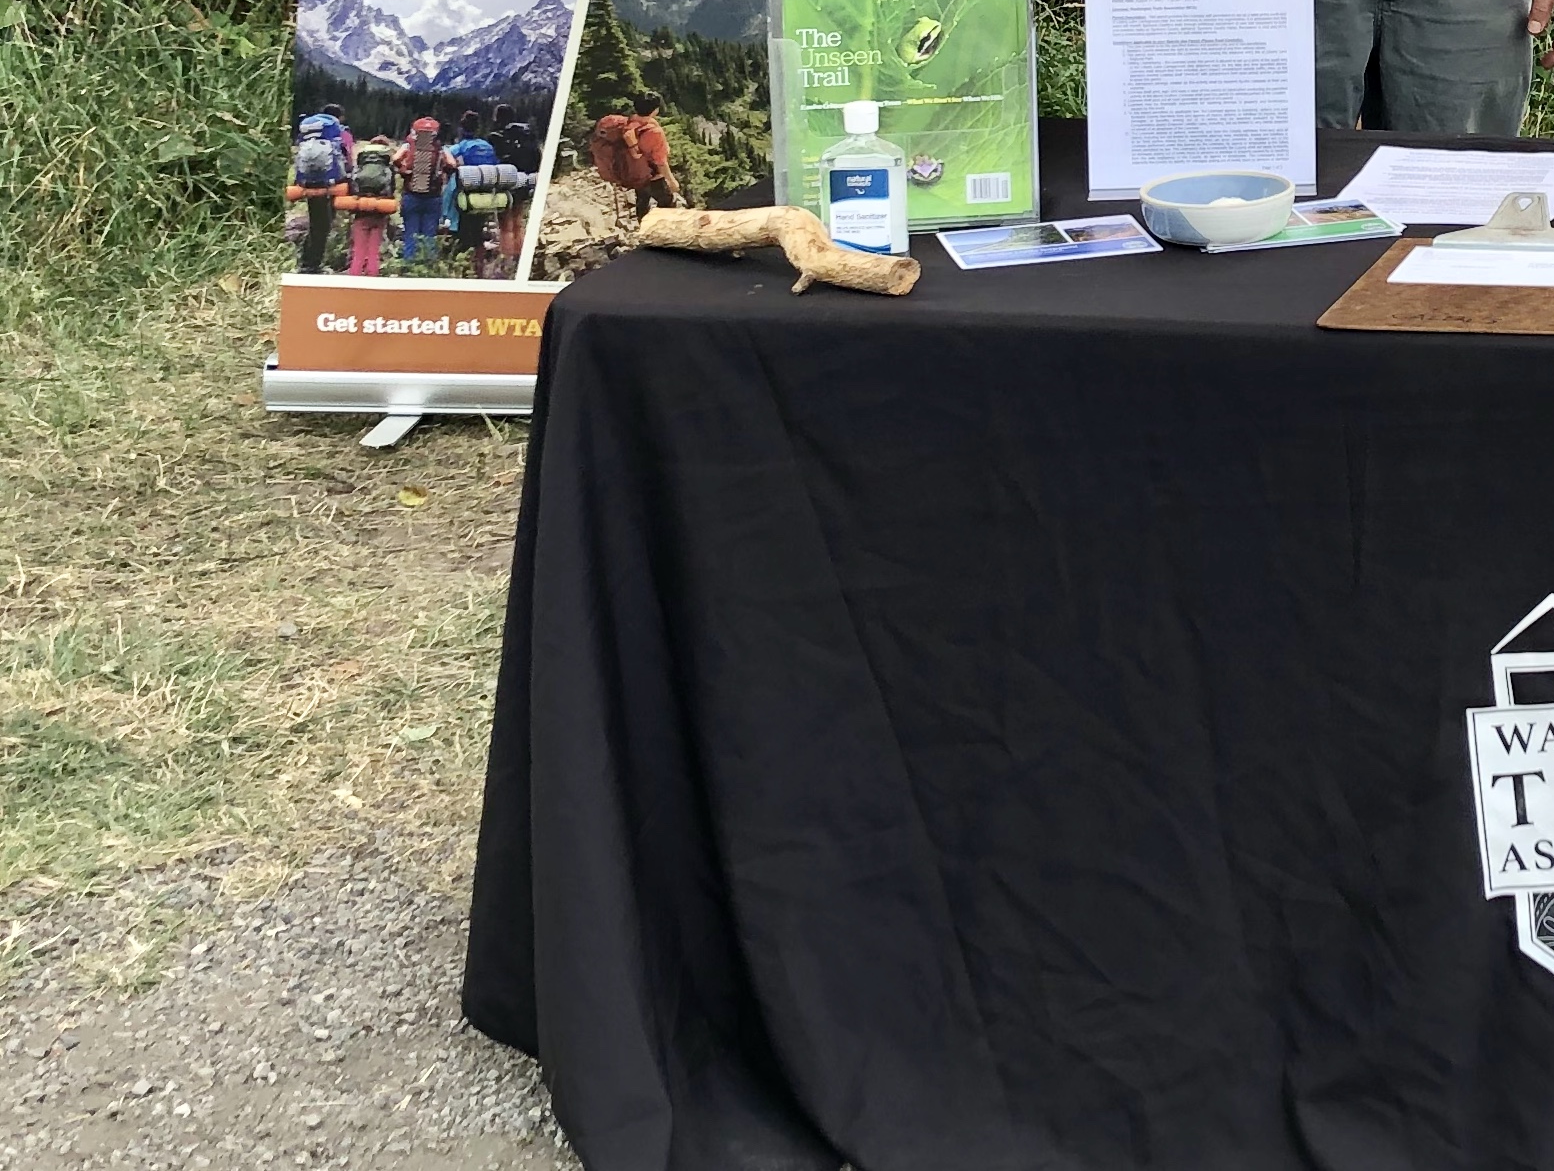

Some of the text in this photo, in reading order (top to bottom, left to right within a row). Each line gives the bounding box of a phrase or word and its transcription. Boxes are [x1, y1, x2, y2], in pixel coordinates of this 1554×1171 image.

[796, 28, 842, 48] The
[799, 48, 883, 69] Unseen
[797, 66, 851, 88] Trail
[316, 313, 358, 333] Get
[362, 315, 450, 336] started
[455, 318, 481, 337] at
